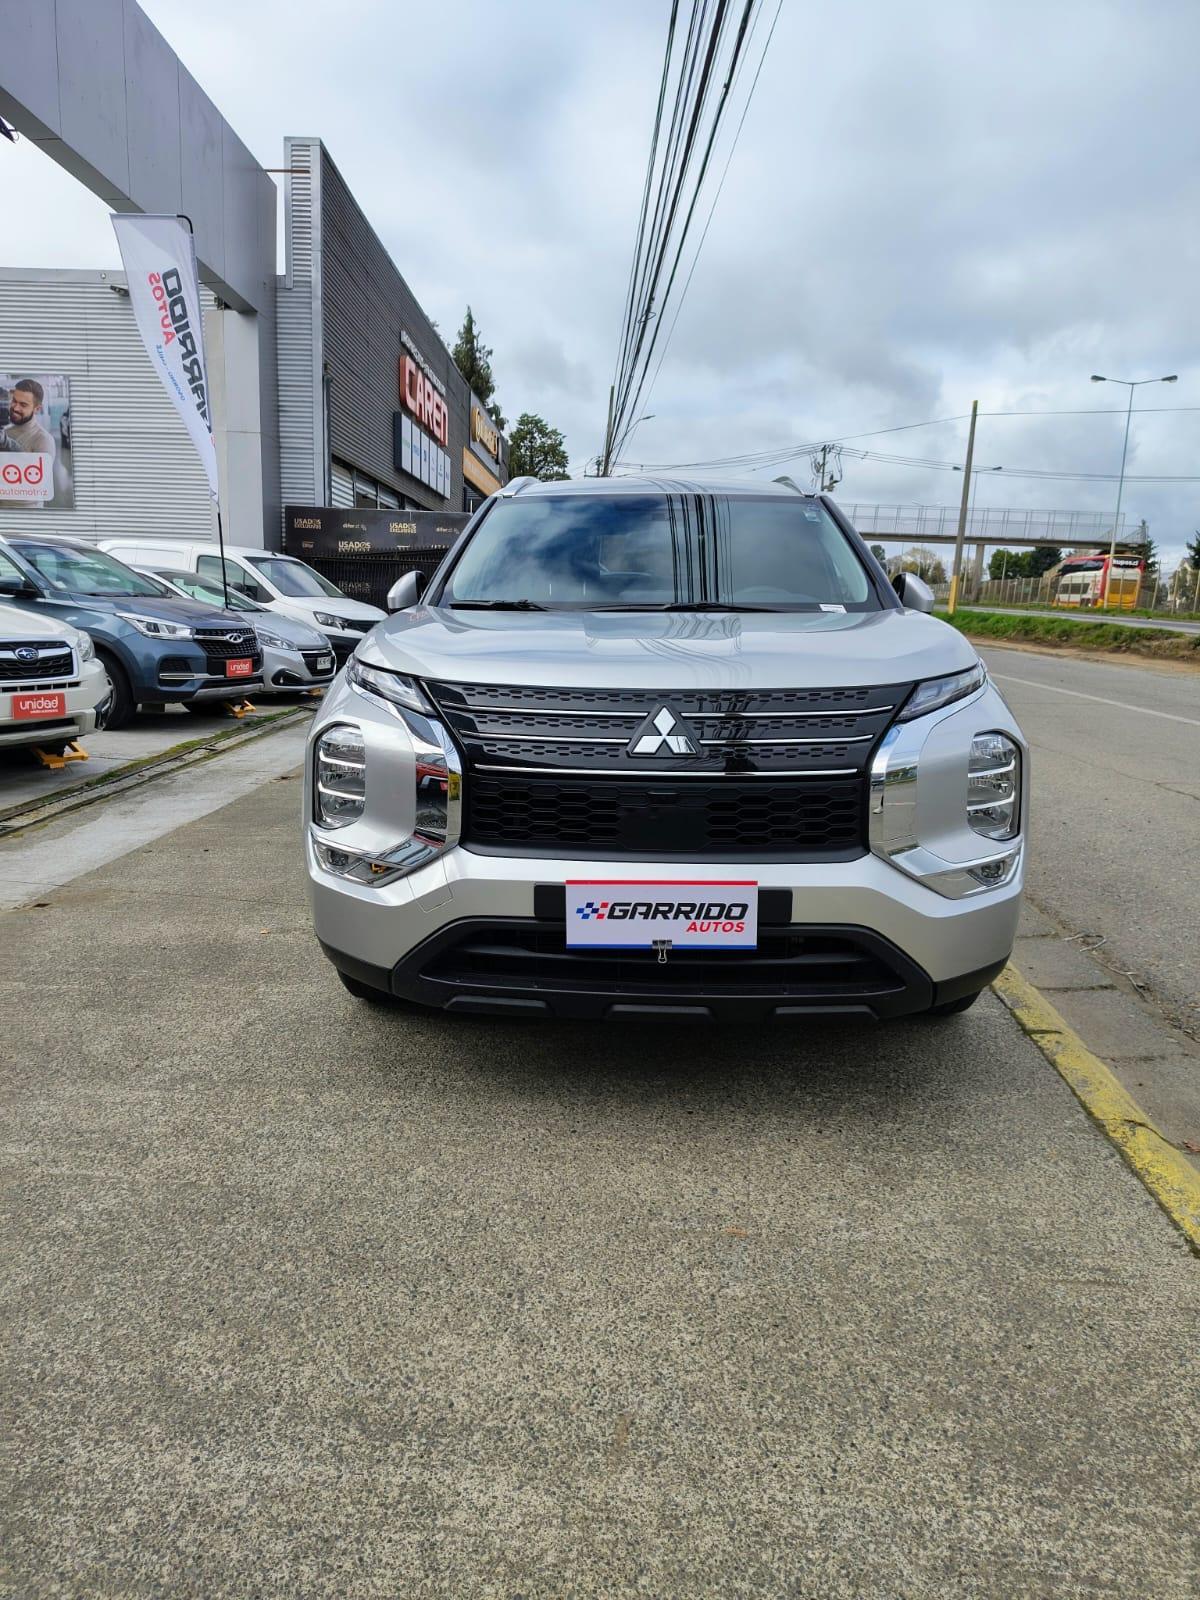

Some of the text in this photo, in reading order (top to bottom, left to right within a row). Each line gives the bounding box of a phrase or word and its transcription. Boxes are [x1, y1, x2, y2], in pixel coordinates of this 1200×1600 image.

[230, 661, 250, 671] unidad
[20, 696, 58, 710] unidad
[606, 902, 749, 921] GARRIDO
[686, 921, 745, 933] AUTOS
